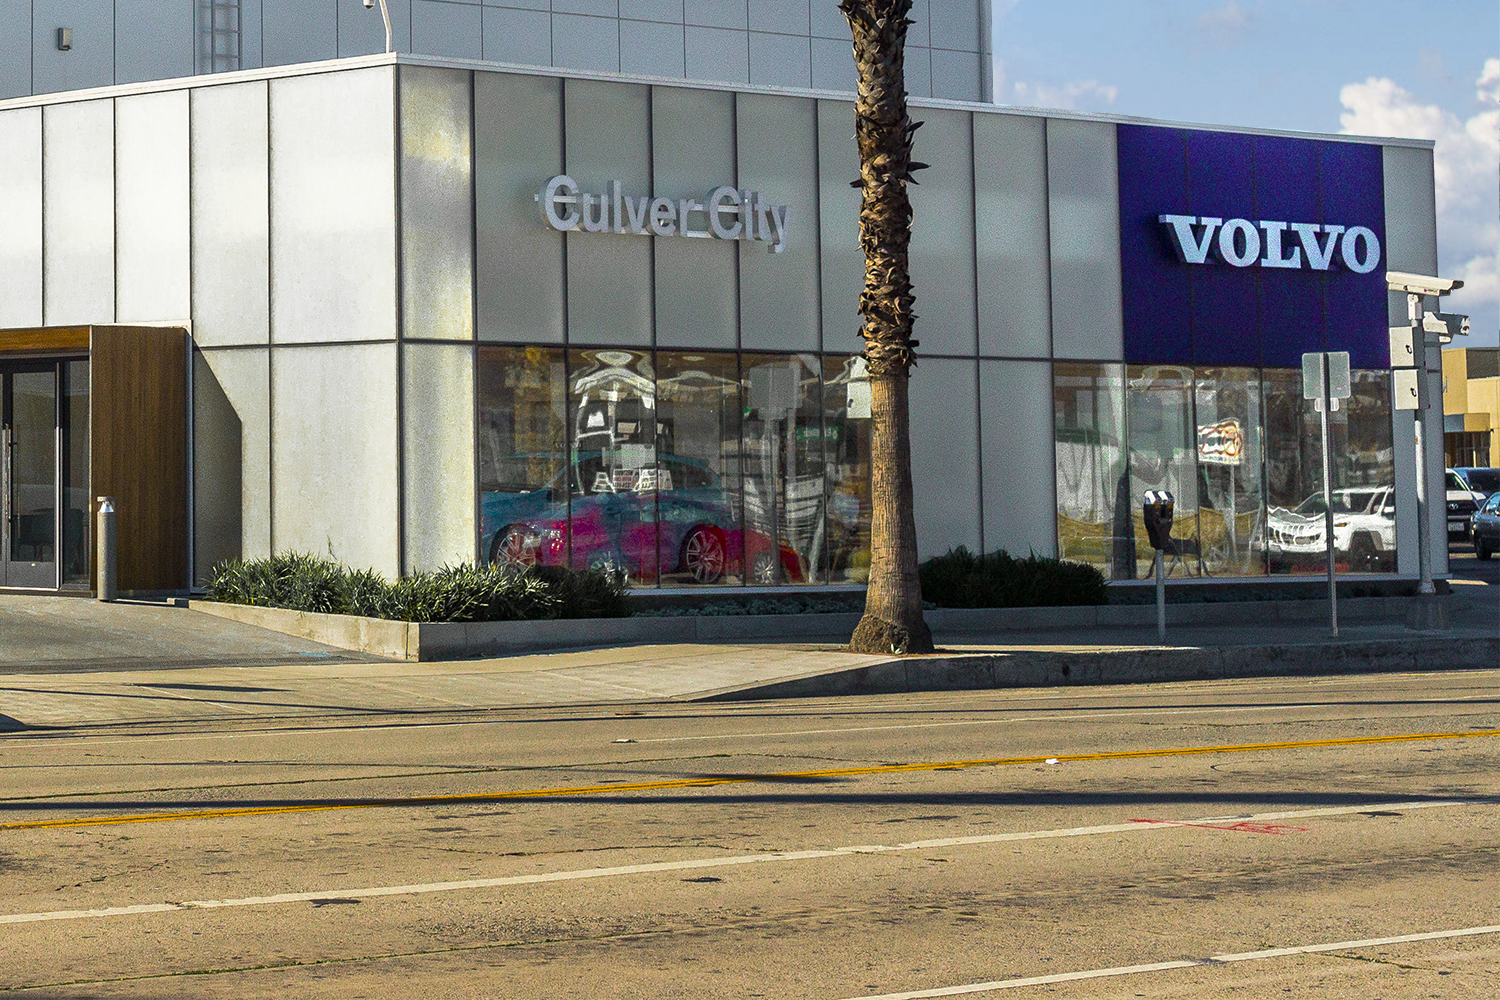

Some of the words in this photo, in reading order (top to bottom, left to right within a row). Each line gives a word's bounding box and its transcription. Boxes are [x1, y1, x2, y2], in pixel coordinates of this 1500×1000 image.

[540, 174, 696, 238] Culver
[707, 185, 792, 254] City
[1158, 214, 1381, 274] VOLVO
